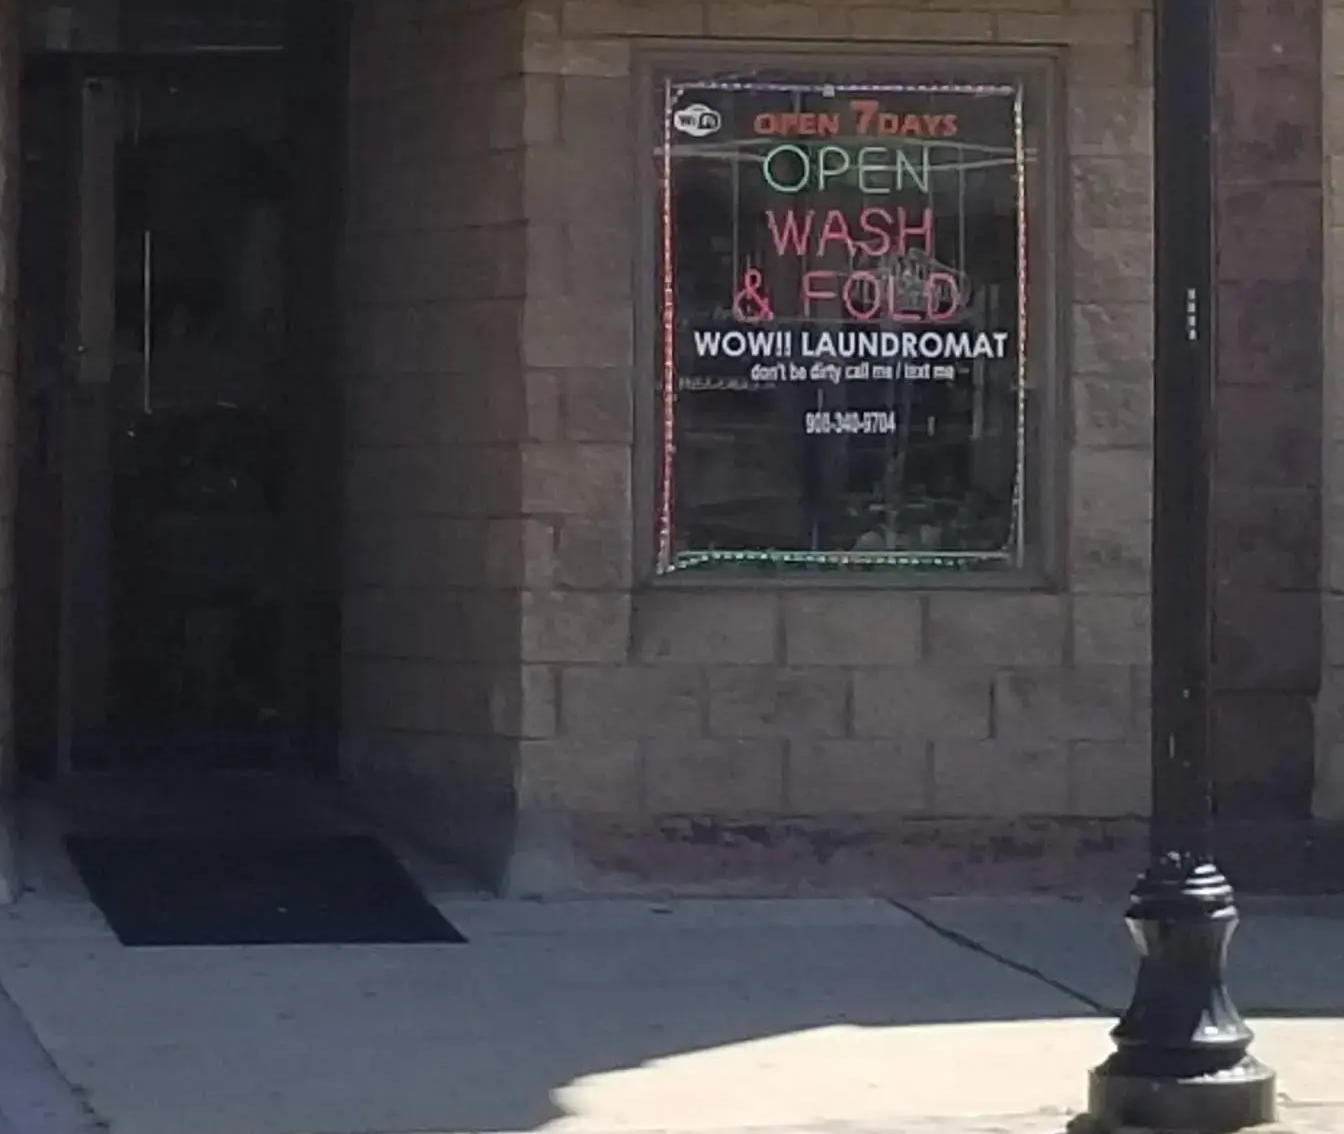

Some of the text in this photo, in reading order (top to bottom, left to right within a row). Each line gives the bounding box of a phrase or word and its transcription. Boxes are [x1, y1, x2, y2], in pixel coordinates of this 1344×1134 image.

[754, 112, 839, 135] OPEN
[763, 144, 929, 194] OPEN
[766, 206, 935, 257] WASH
[732, 268, 962, 324] & FOLD
[694, 331, 1008, 358] WOW!! LAUNDROMAT
[751, 364, 786, 380] don't
[789, 364, 807, 380] be
[810, 363, 842, 384] dirty
[844, 363, 869, 380] call
[872, 366, 892, 380] me
[904, 364, 931, 380] text
